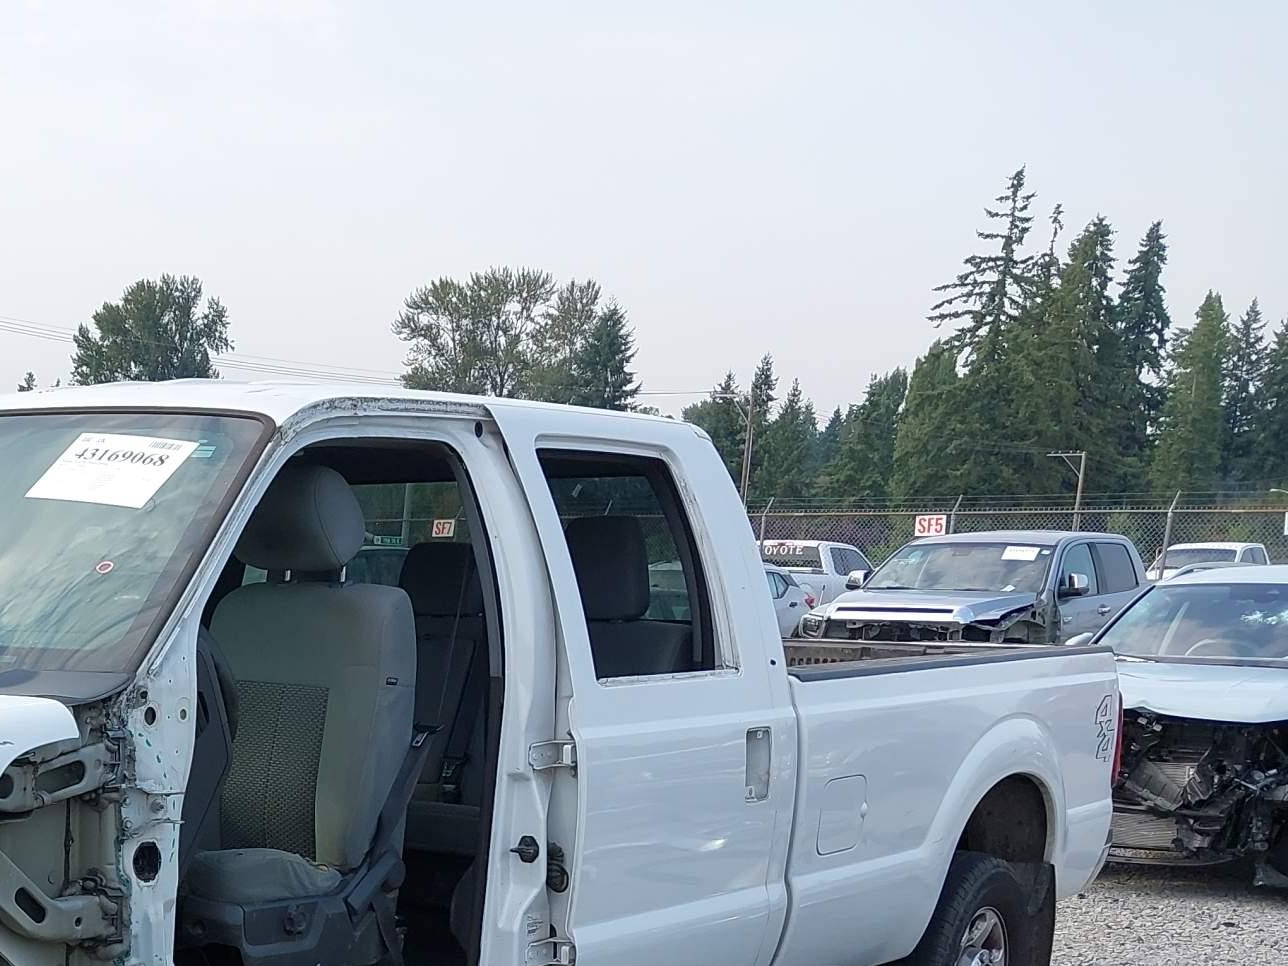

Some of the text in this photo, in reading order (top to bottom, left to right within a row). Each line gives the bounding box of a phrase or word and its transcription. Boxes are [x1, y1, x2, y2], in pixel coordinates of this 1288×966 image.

[74, 447, 170, 467] 43169068
[434, 521, 452, 535] SF7
[917, 517, 944, 534] SF5
[764, 545, 804, 555] OYOTE
